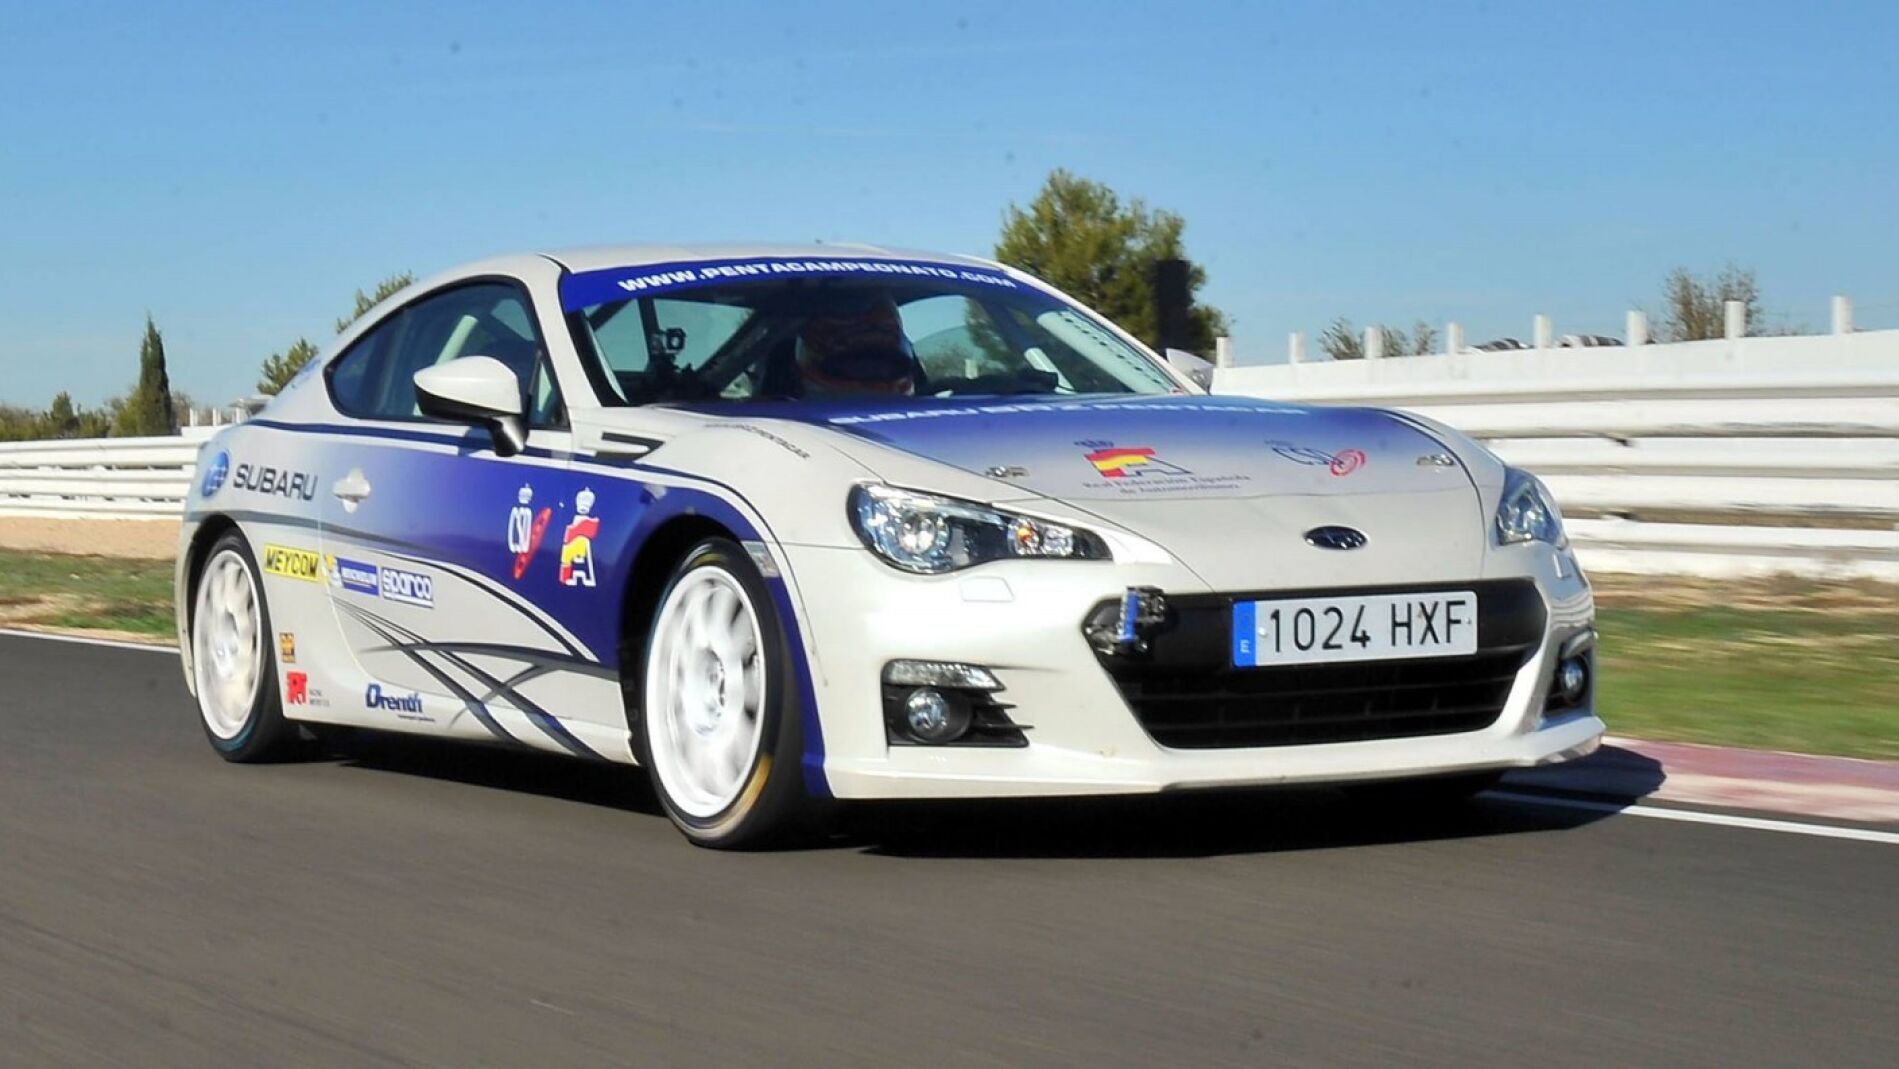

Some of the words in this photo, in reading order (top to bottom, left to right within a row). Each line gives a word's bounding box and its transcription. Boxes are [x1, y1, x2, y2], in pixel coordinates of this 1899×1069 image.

[618, 261, 1017, 291] WWW.PENTACAMPEONATO.COM
[232, 463, 319, 500] SUBARU
[265, 548, 319, 579] MEYCOM
[1270, 604, 1371, 653] 1024
[1391, 600, 1466, 648] HXF
